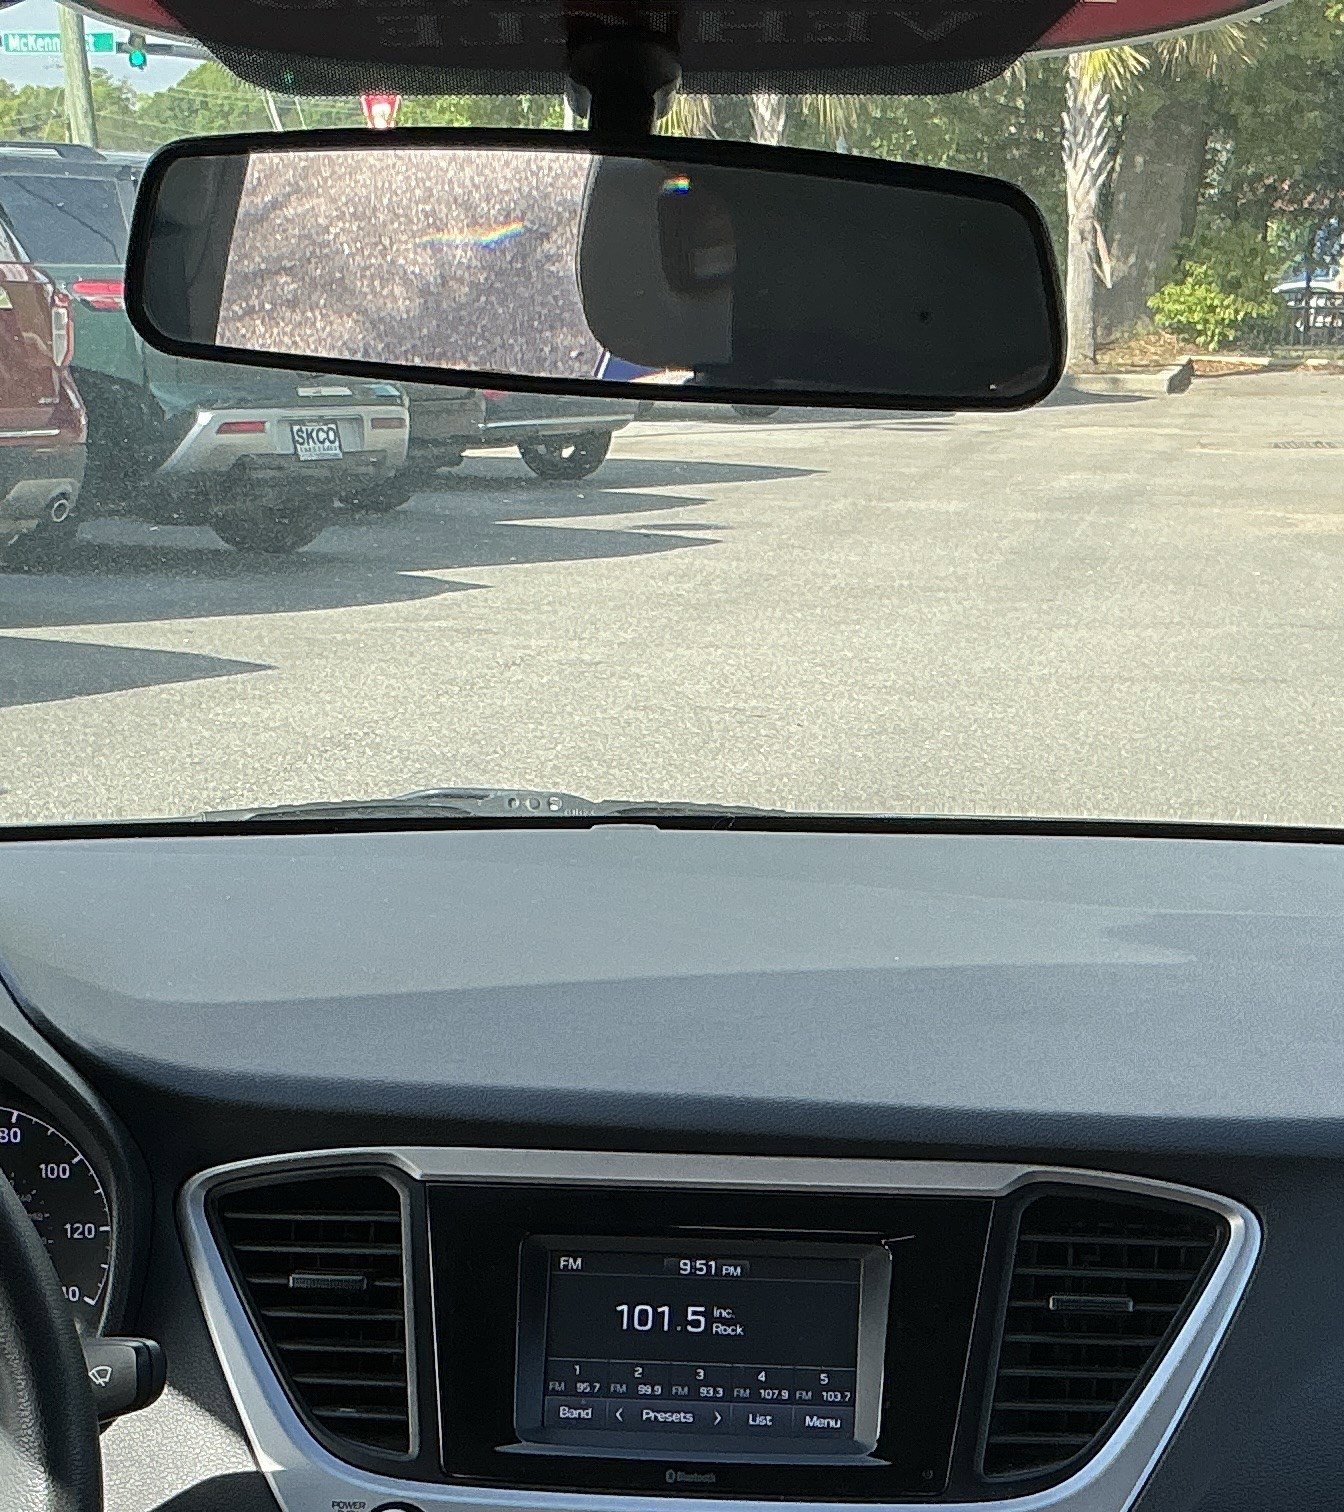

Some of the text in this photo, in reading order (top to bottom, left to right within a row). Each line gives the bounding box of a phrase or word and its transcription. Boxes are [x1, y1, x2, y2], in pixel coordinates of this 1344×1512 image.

[8, 34, 60, 52] McKenn
[296, 427, 337, 446] SKCO
[39, 1163, 70, 1179] 100
[64, 1223, 96, 1239] 120
[560, 1256, 582, 1271] FM
[678, 1259, 742, 1277] 9:51 PM
[615, 1304, 706, 1333] 101.5
[713, 1305, 736, 1319] Inc.
[712, 1322, 744, 1337] Rock
[573, 1364, 582, 1375] 1
[633, 1367, 643, 1378] 2
[696, 1369, 705, 1380] 3
[757, 1371, 767, 1383] 4
[819, 1373, 829, 1385] 5
[559, 1405, 593, 1420] Band
[642, 1408, 694, 1424] Presets
[748, 1412, 773, 1426] List
[805, 1414, 842, 1430] Menu
[331, 1500, 367, 1511] POWER
